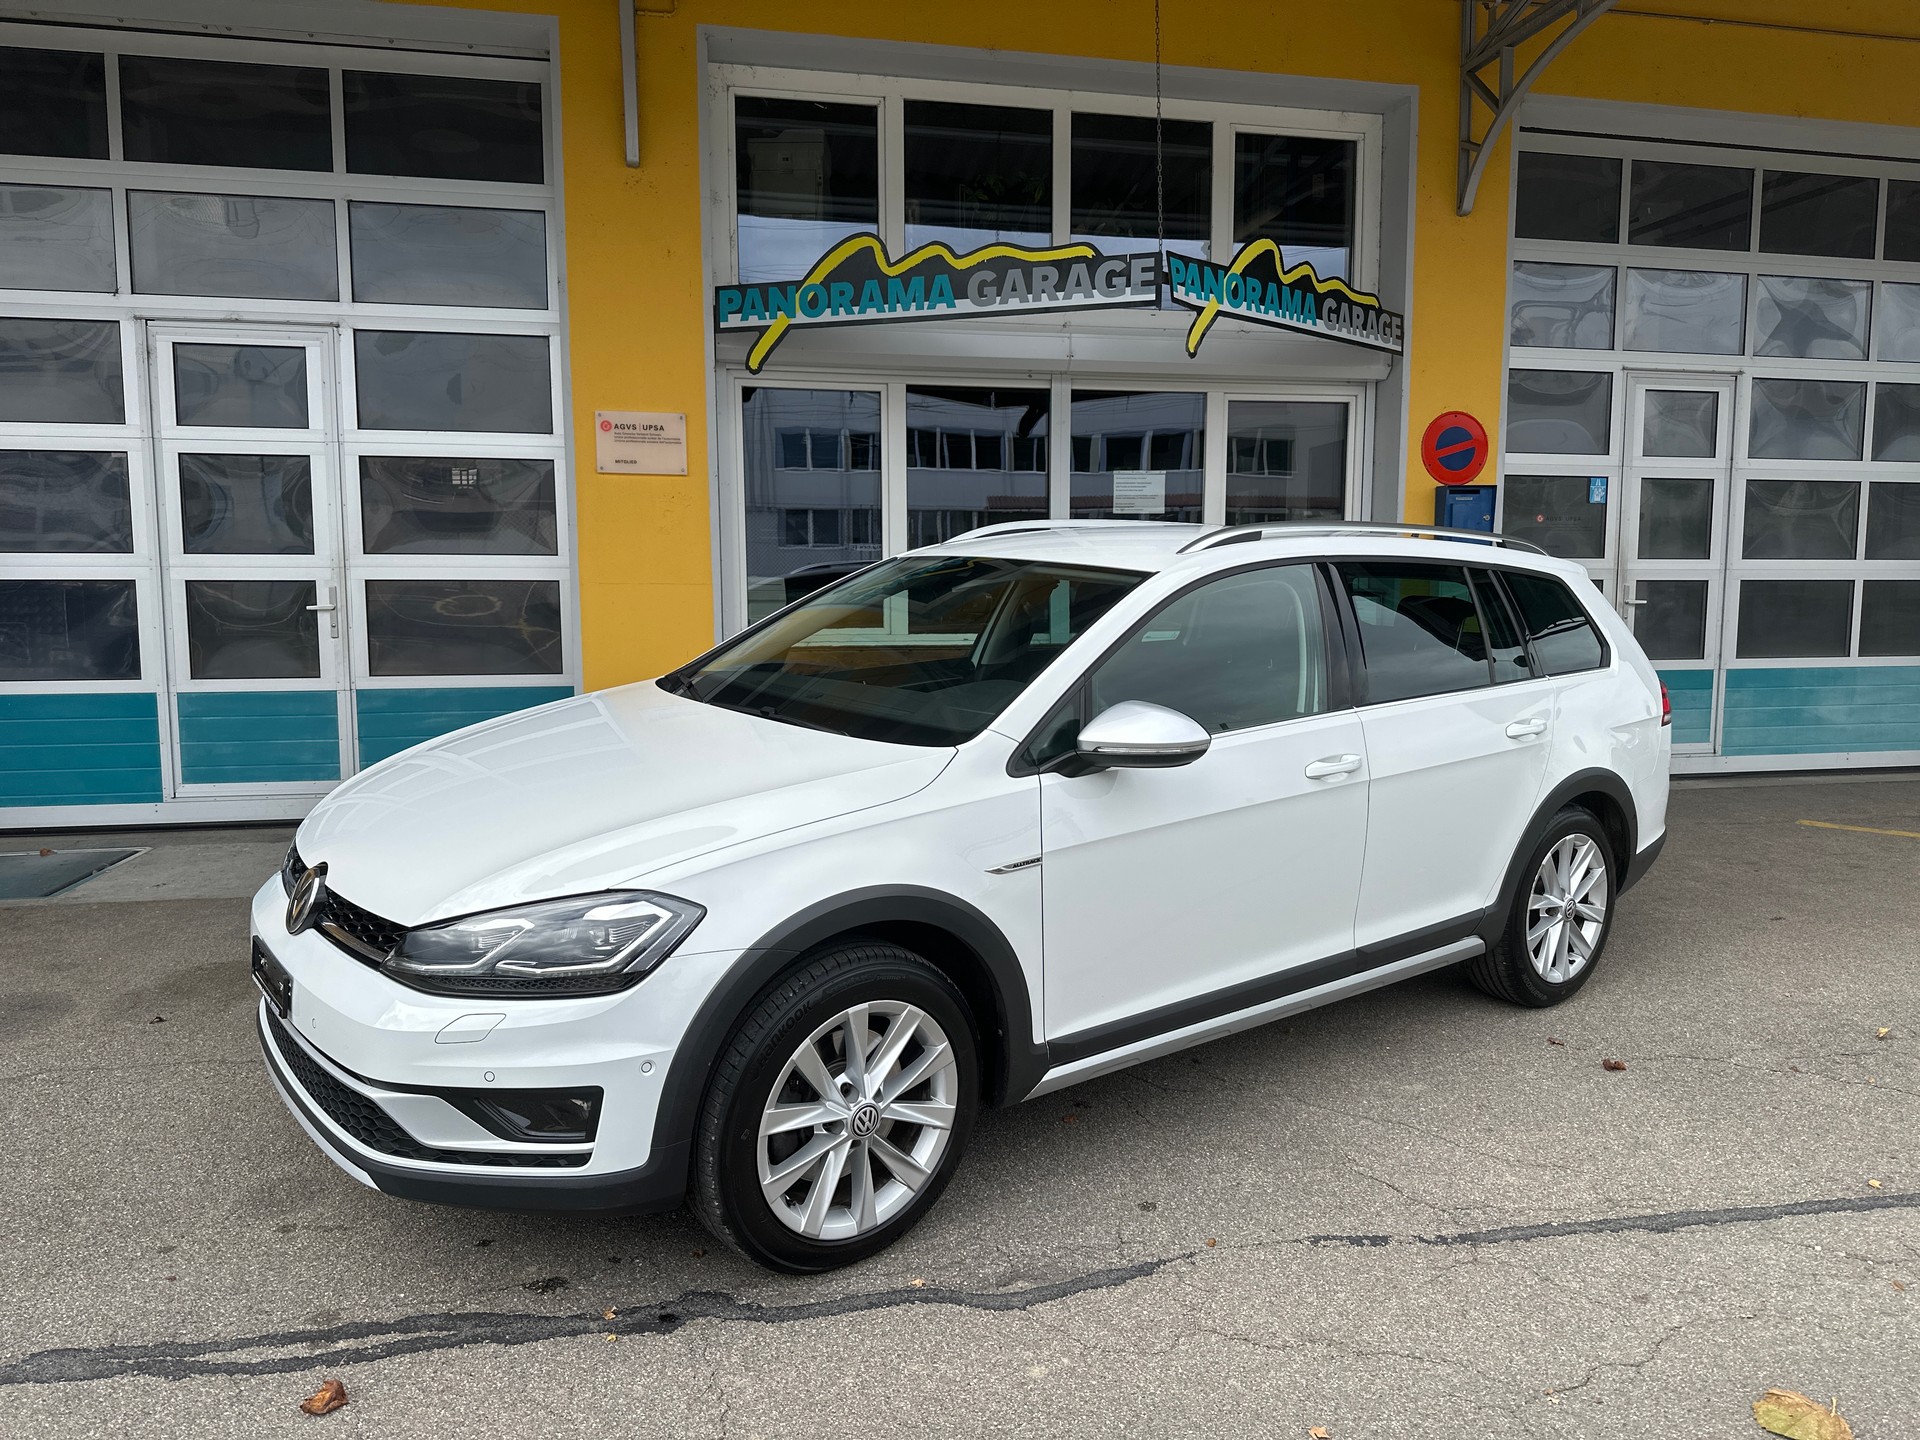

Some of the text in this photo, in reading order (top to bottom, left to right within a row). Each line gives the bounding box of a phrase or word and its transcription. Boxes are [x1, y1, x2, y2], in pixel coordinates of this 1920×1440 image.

[719, 258, 1156, 323] PANORAMA GARAGE
[1170, 256, 1402, 347] PANORAMA GARAGE
[613, 423, 665, 432] AGVS UPSA
